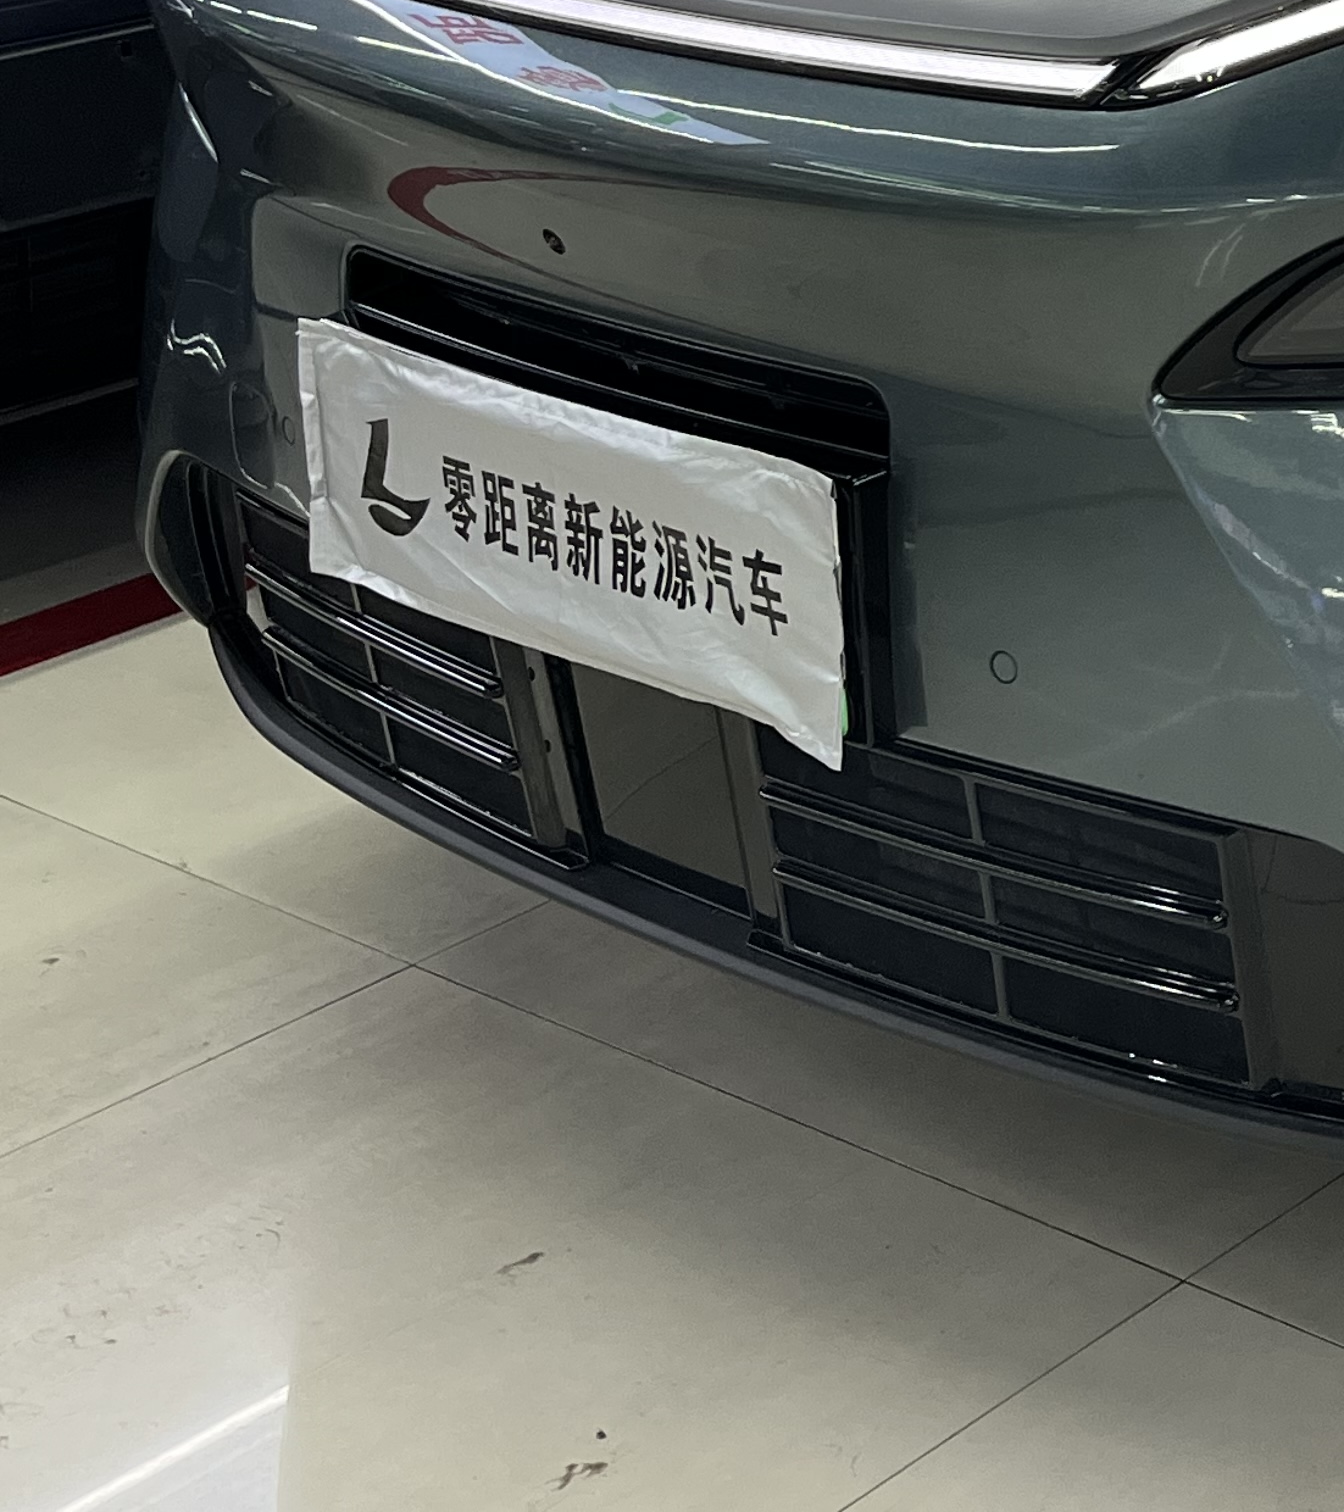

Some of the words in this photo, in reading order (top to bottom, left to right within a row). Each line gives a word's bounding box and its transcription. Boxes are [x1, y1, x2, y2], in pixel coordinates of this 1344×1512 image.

[441, 455, 790, 636] 零距离新能源汽车
